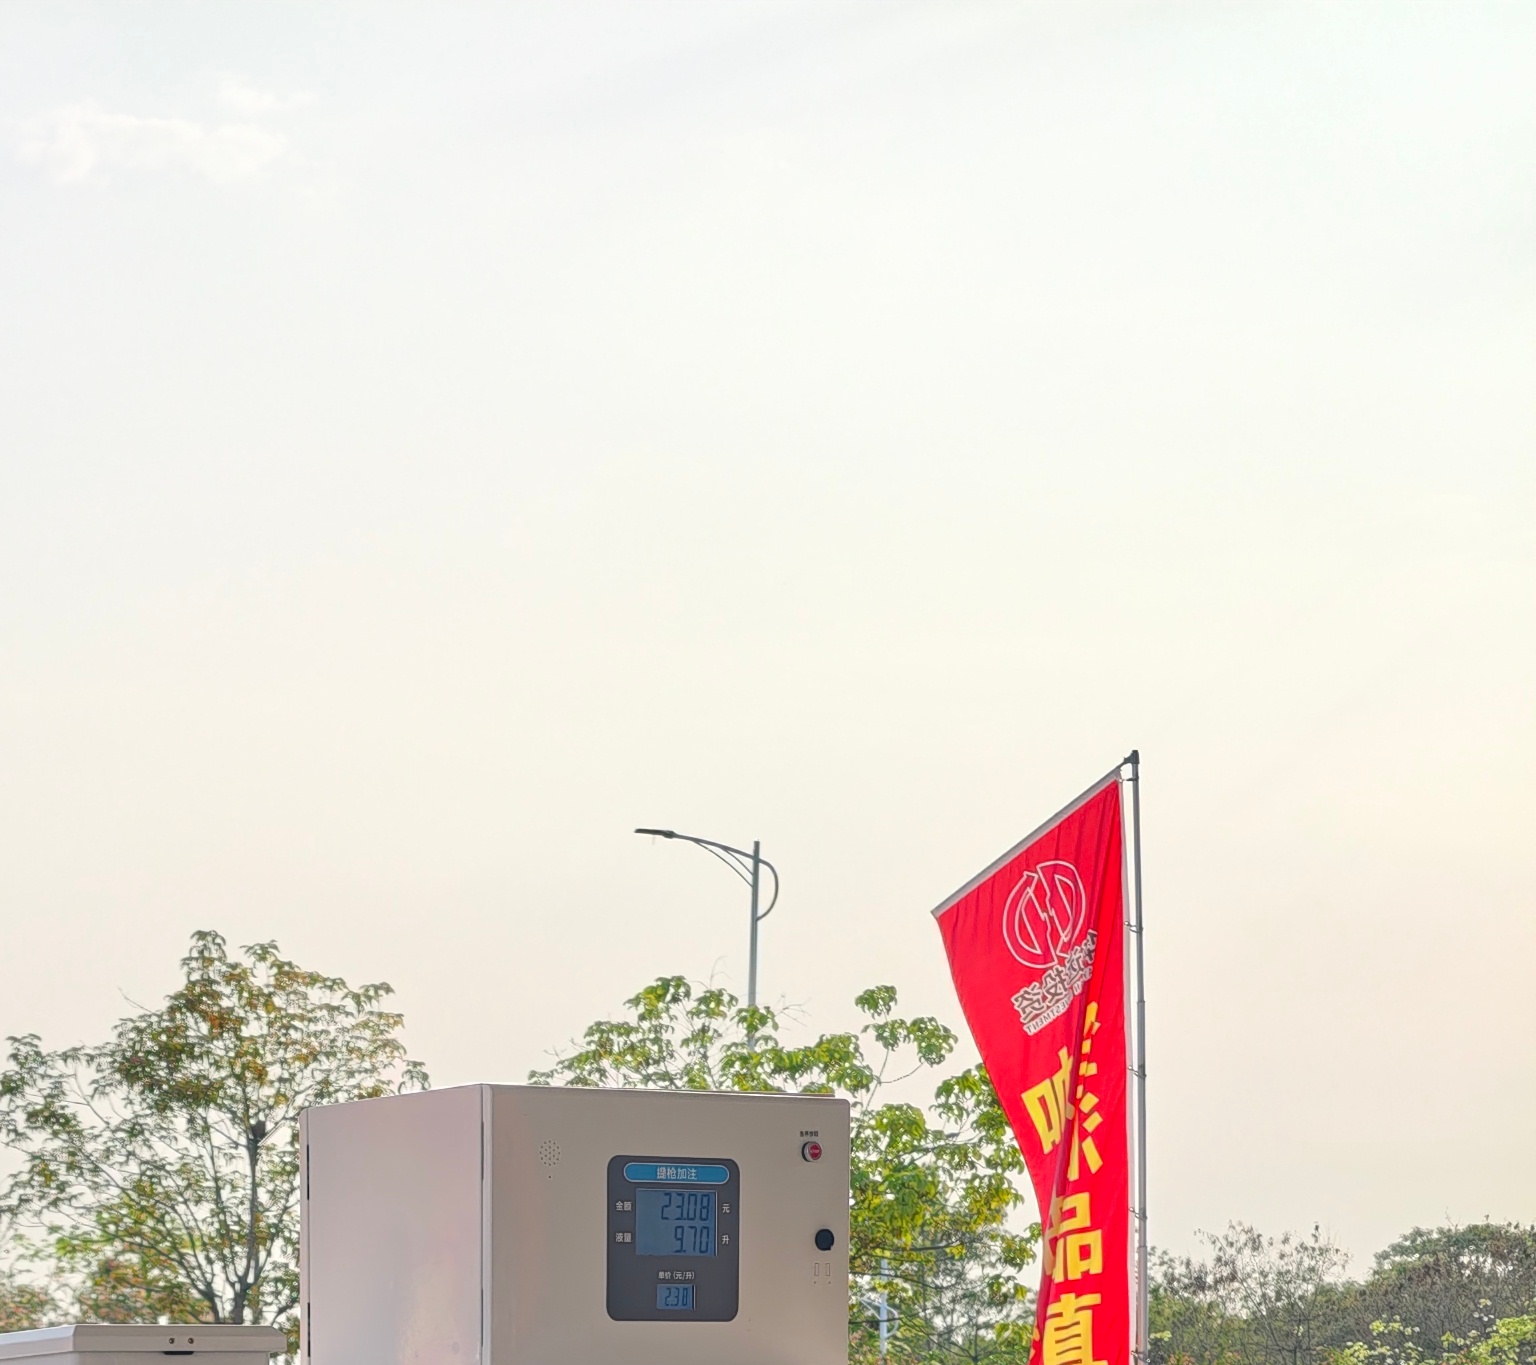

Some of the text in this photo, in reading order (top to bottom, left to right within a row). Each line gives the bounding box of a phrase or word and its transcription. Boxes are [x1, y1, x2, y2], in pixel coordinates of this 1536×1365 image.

[656, 1166, 698, 1181] 提枪加注
[661, 1192, 711, 1221] 23.08
[722, 1203, 731, 1214] 元
[674, 1225, 710, 1254] 9.70
[721, 1234, 730, 1245] 升
